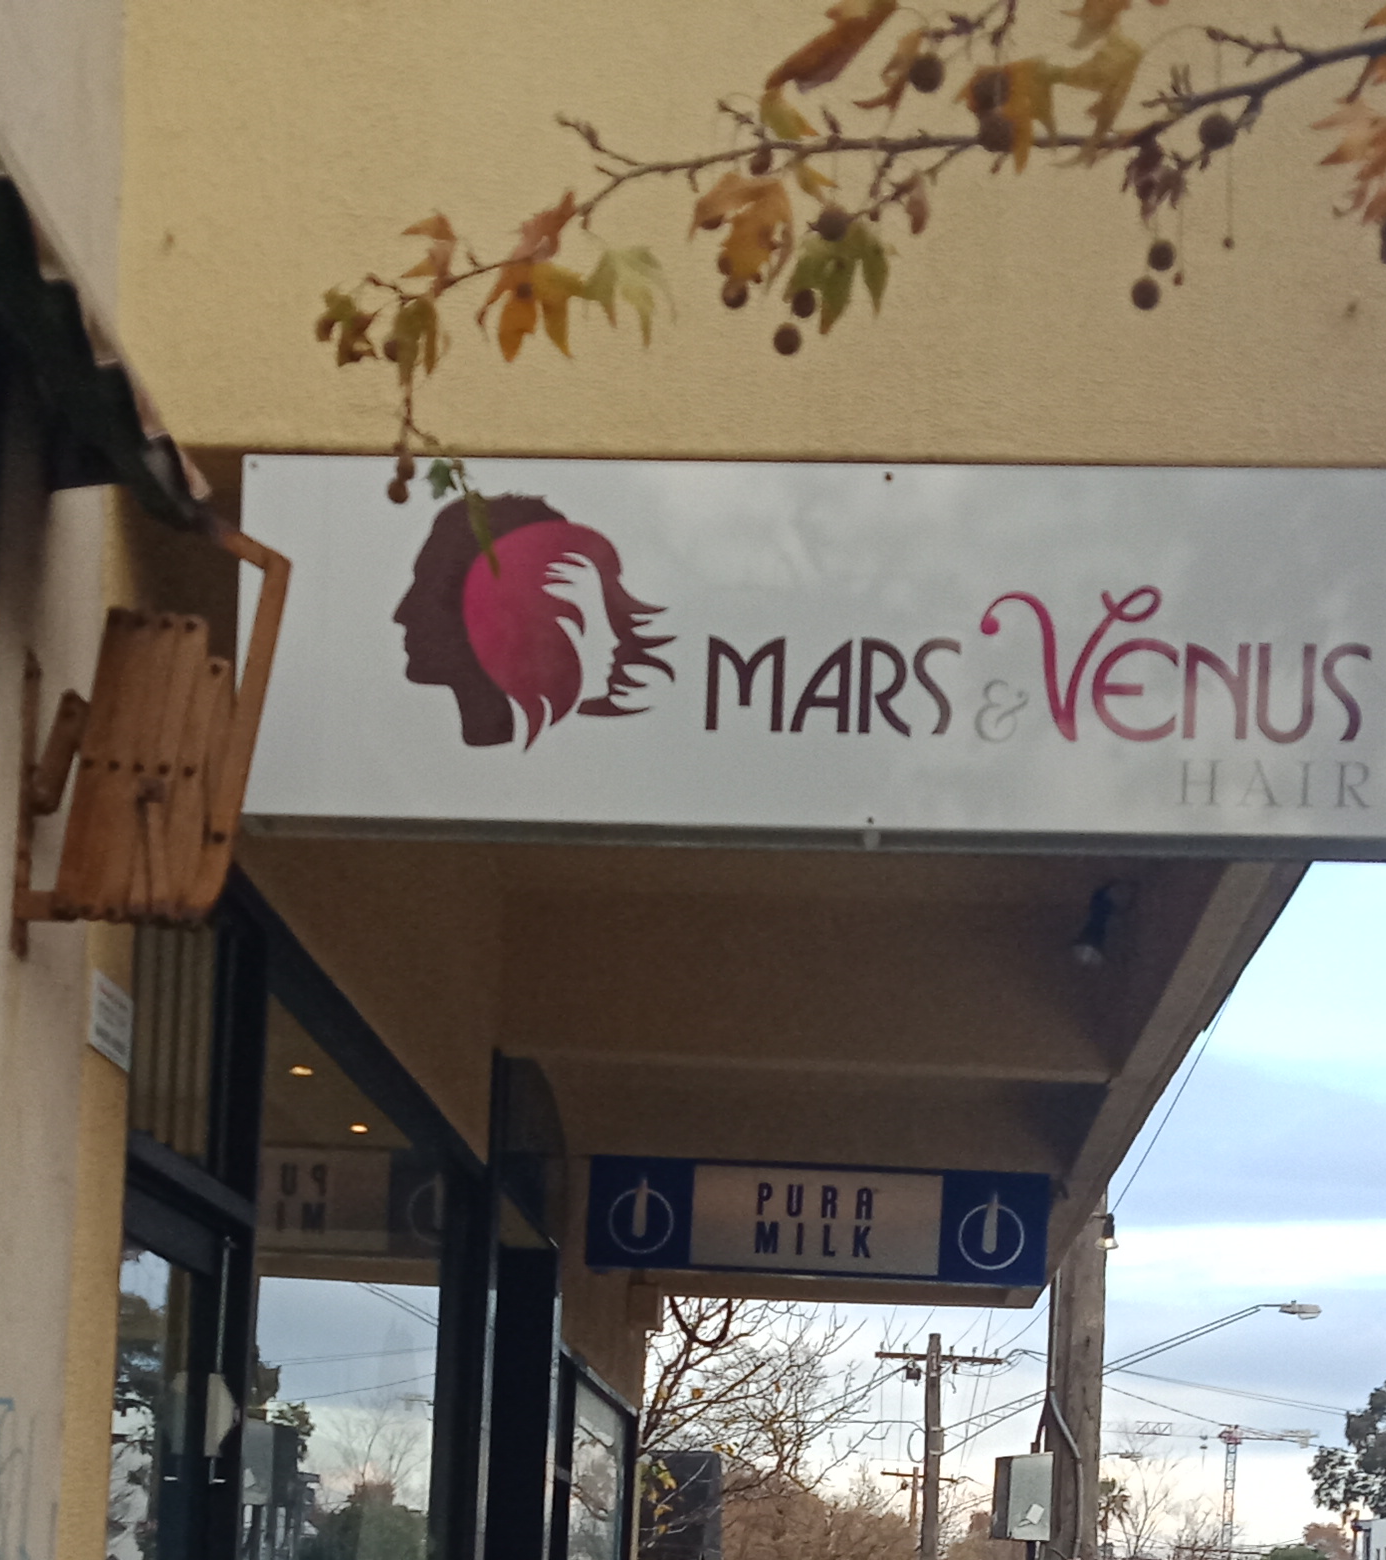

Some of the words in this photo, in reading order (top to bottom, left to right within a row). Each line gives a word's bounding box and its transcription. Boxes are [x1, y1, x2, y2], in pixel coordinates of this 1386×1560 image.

[703, 635, 962, 736] MARS
[981, 585, 1373, 745] VENUS
[974, 679, 1029, 744] &
[1178, 758, 1371, 810] HAIR
[757, 1181, 875, 1220] PURA
[753, 1221, 873, 1259] MILK
